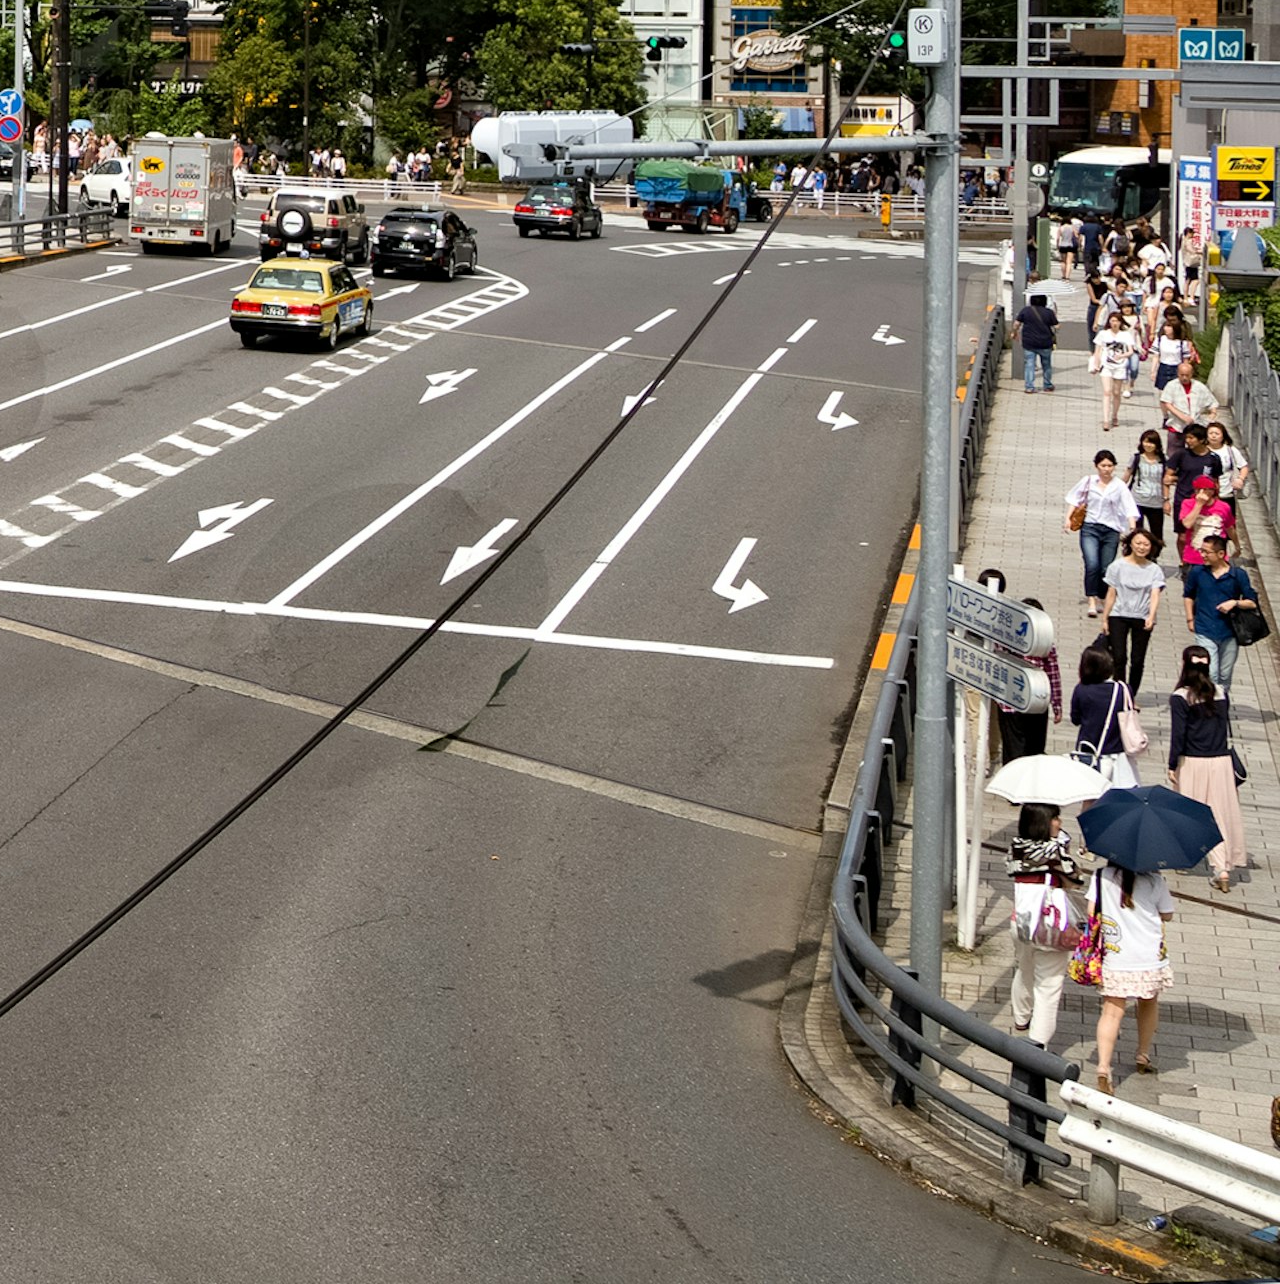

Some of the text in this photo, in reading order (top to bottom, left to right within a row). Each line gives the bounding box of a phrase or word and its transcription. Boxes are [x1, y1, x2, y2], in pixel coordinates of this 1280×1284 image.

[731, 34, 810, 71] Garrett
[917, 44, 934, 57] 13P
[1226, 157, 1268, 172] Times
[1217, 208, 1270, 218] 平日最大料金
[1226, 220, 1260, 228] あります
